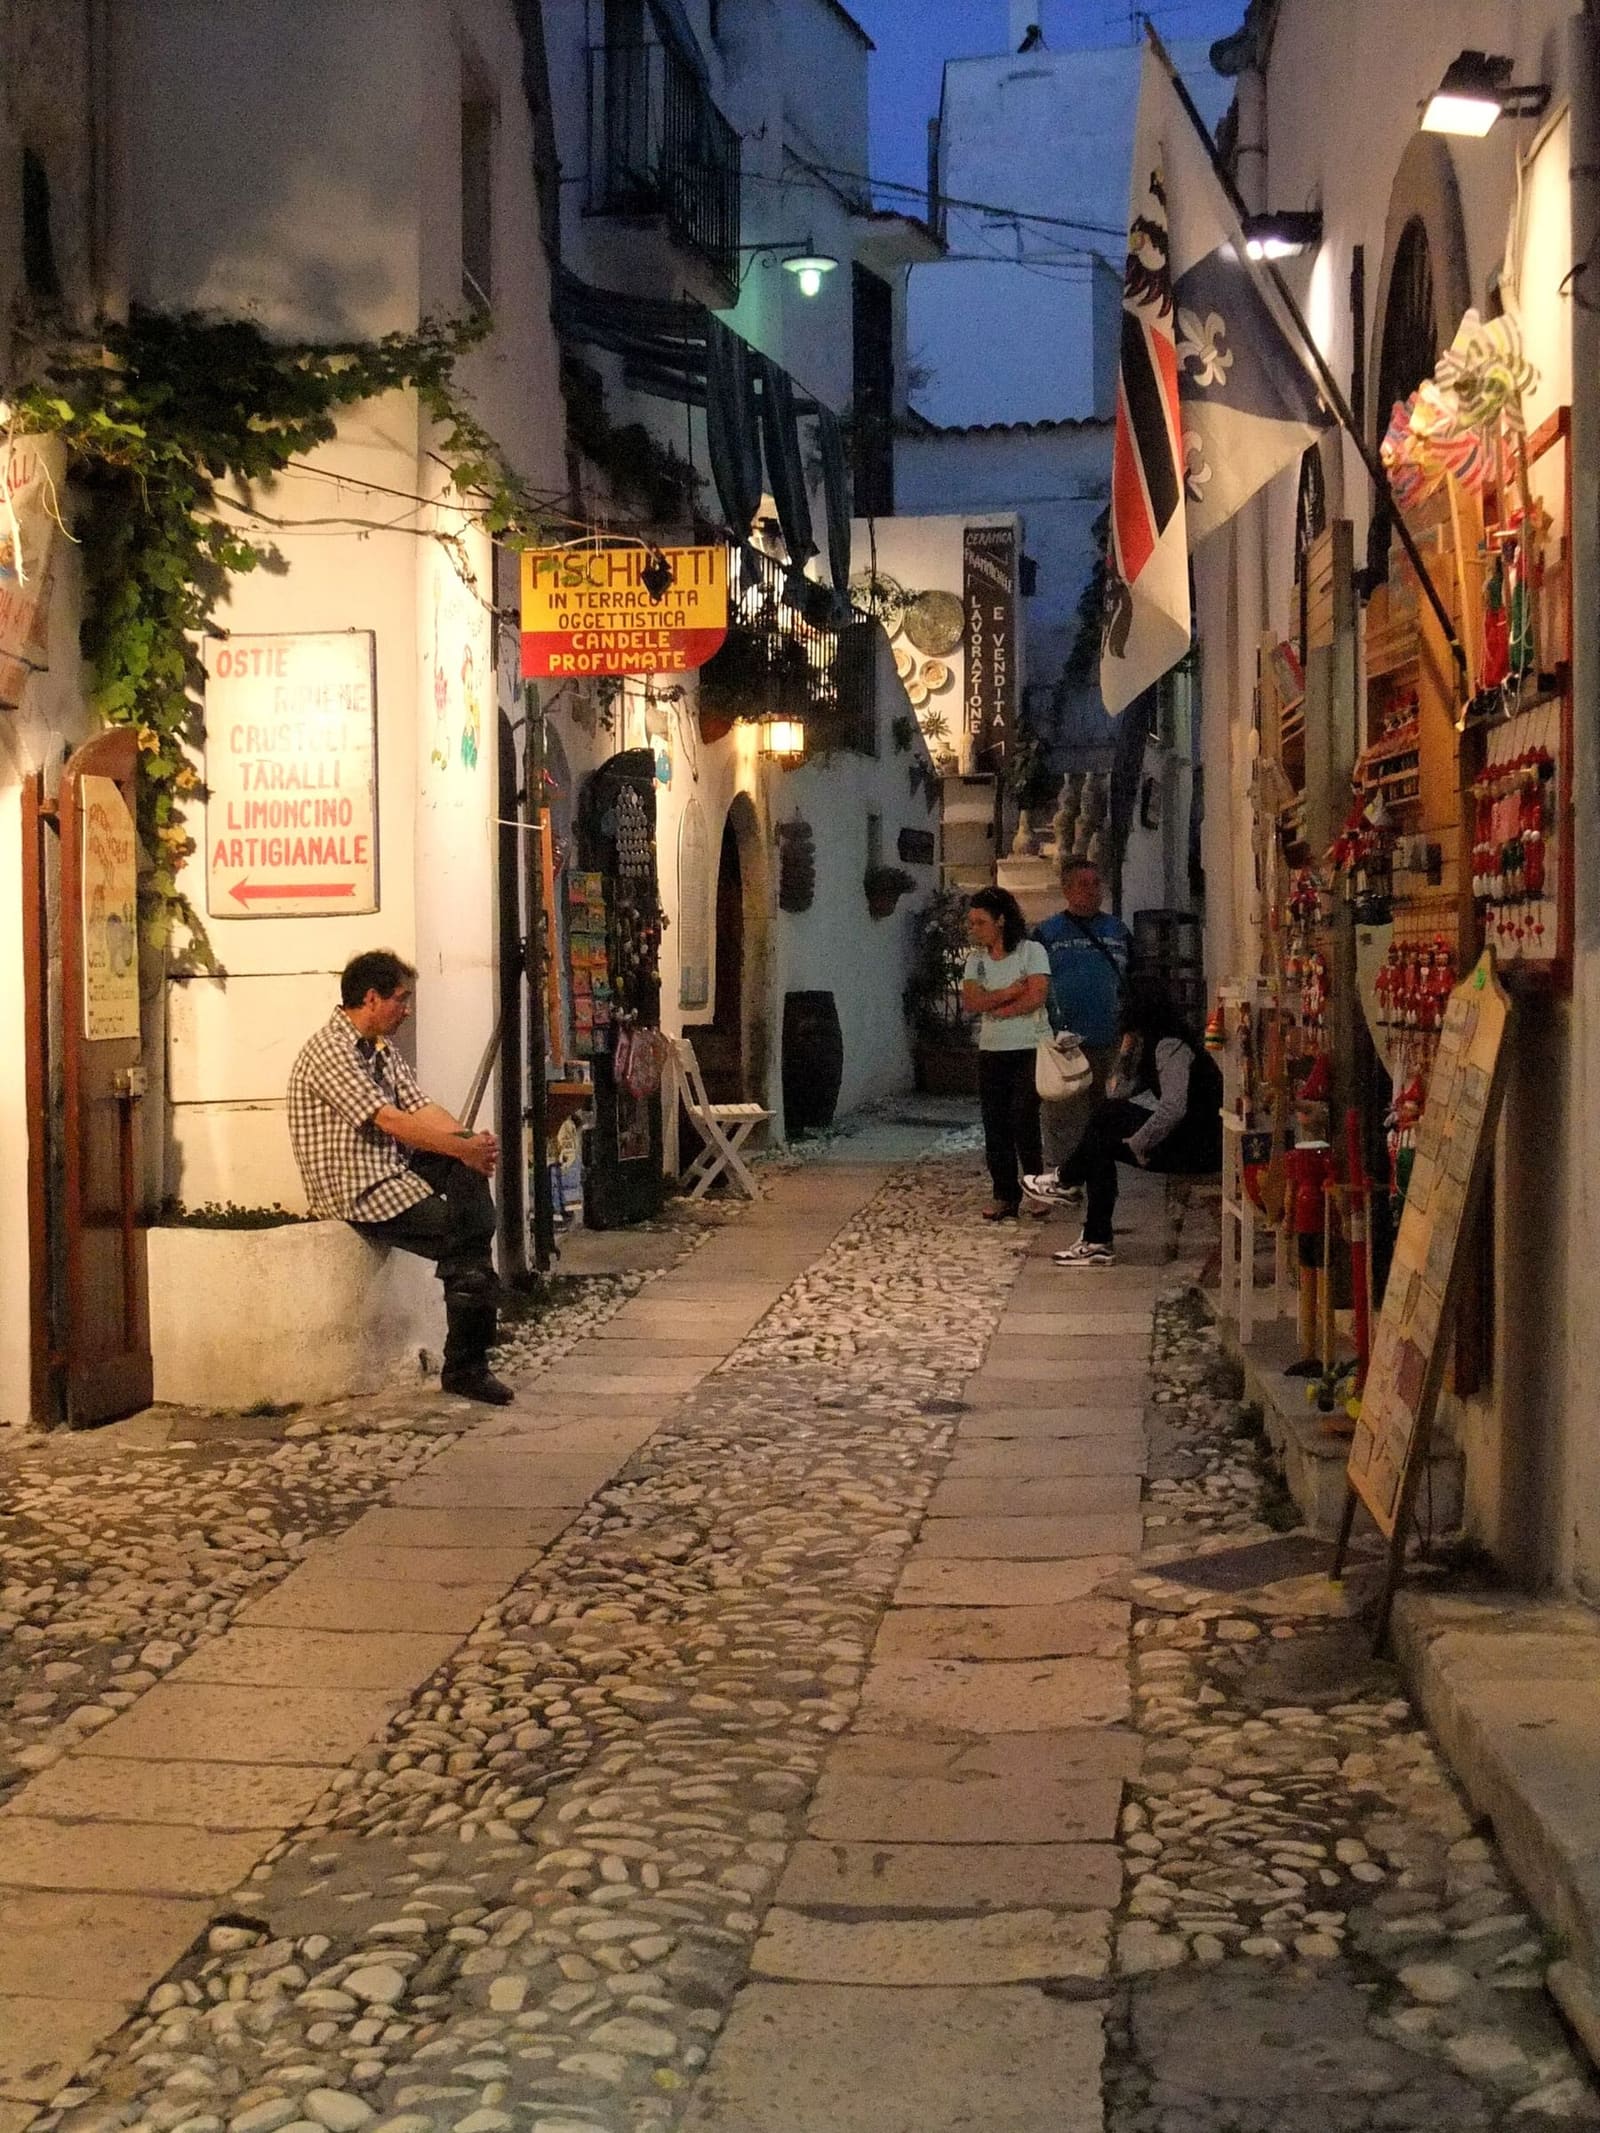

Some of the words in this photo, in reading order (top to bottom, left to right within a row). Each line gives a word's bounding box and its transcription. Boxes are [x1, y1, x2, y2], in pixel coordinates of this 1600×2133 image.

[531, 549, 715, 590] FISCHITTI
[548, 592, 568, 609] IN
[992, 606, 1005, 621] E
[558, 610, 686, 630] OGGETTISTICA
[571, 630, 671, 650] CANDELE
[216, 648, 289, 678] OSTIE
[548, 650, 687, 672] PROFUMATE
[969, 595, 983, 735] LAVORAZIONE
[992, 633, 1006, 728] VENDITA
[239, 760, 341, 791] TARALLI
[227, 798, 353, 830] LIMONCINO
[212, 835, 369, 868] ARTIGIANALE
